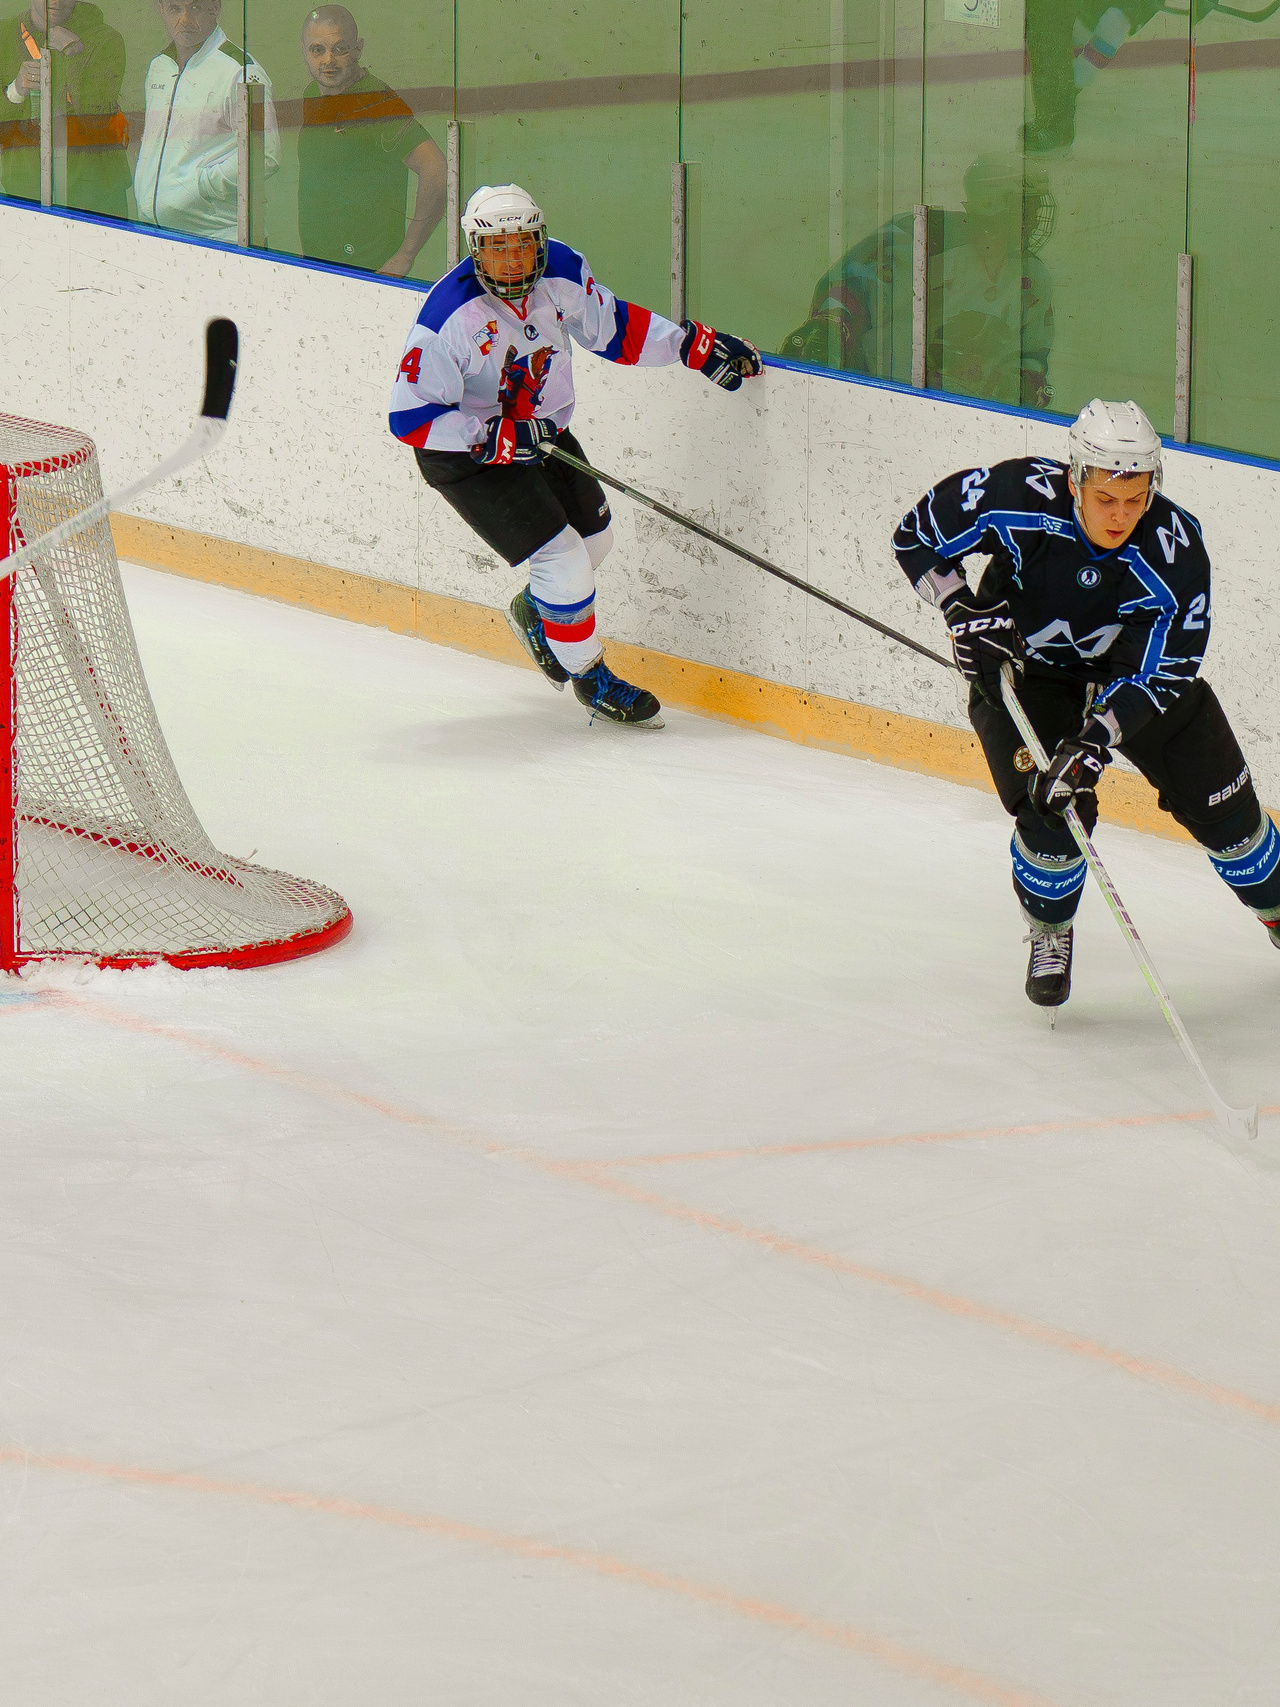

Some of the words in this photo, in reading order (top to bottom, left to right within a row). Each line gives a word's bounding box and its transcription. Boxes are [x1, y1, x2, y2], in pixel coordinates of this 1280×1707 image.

[395, 346, 423, 385] 4
[1182, 593, 1211, 630] 2
[951, 616, 1014, 638] CCM
[1022, 872, 1053, 889] ONE
[1225, 865, 1256, 877] ONE
